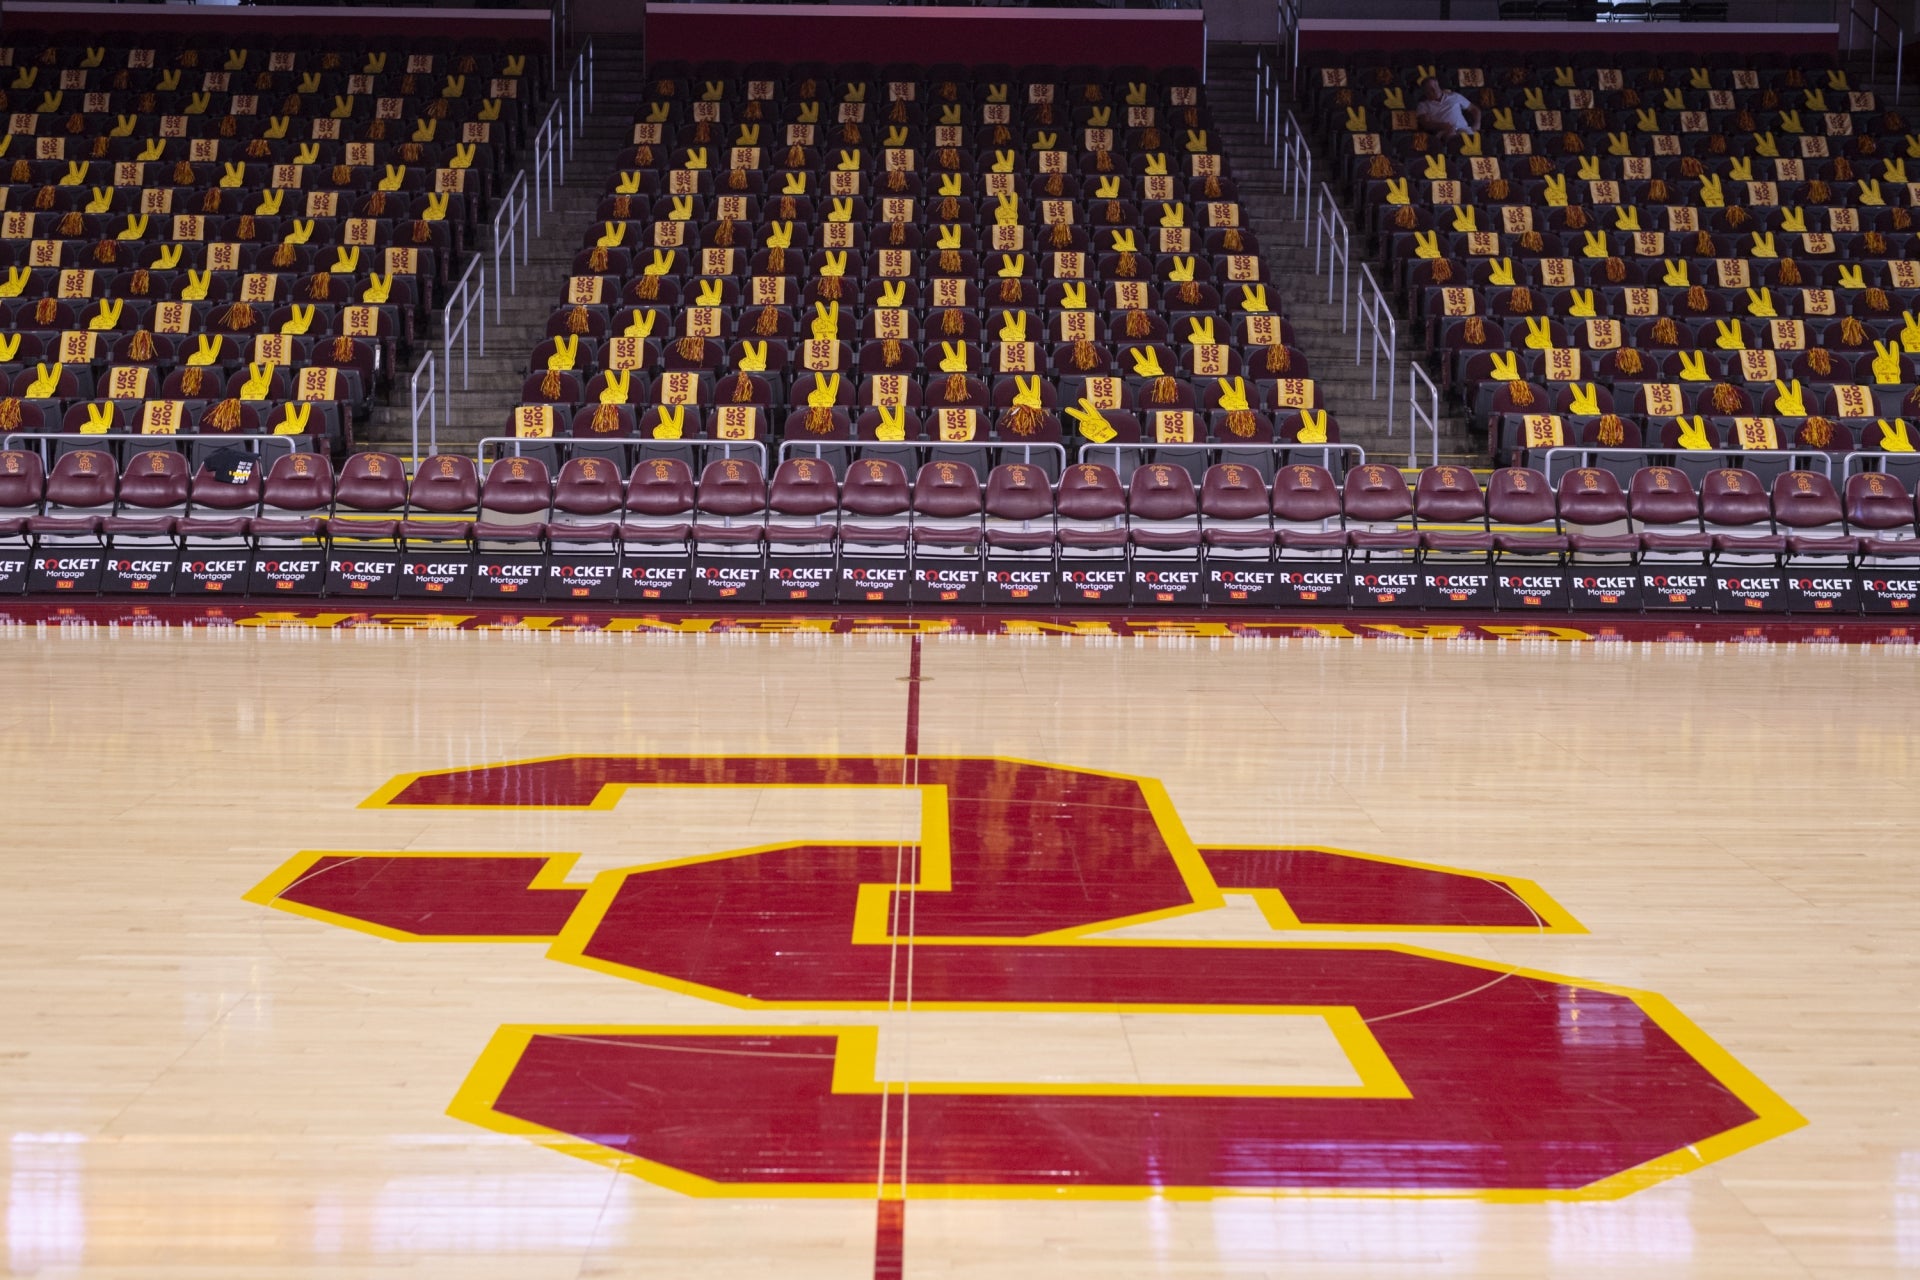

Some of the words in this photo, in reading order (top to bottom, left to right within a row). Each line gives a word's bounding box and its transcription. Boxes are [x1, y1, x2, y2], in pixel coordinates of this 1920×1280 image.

[163, 306, 173, 324] USC
[173, 303, 182, 324] HOO
[694, 309, 702, 325] USC
[1777, 322, 1786, 338] USC
[68, 336, 78, 355] USC
[263, 340, 272, 358] USC
[812, 341, 821, 358] USC
[1007, 345, 1015, 363] USC
[1202, 345, 1210, 362] USC
[1553, 350, 1561, 368] USC
[1748, 351, 1756, 369] USC
[117, 370, 127, 389] USC
[126, 368, 138, 388] HOO
[307, 371, 316, 390] USC
[317, 368, 327, 391] HOO
[670, 374, 679, 392] USC
[880, 376, 889, 394] USC
[1094, 379, 1102, 397] USC
[1652, 385, 1662, 402] USC
[1844, 388, 1853, 406] USC
[151, 406, 162, 425] USC
[524, 408, 533, 427] USC
[726, 408, 735, 426] USC
[948, 410, 956, 429] USC
[1165, 414, 1173, 433] USC
[1542, 415, 1553, 438] HOO
[1533, 420, 1543, 440] USC
[1745, 424, 1755, 443] USC
[34, 559, 100, 570] ROCKET
[107, 560, 172, 572] ROCKET
[181, 560, 246, 573] ROCKET
[255, 561, 320, 572] ROCKET
[330, 561, 395, 573] ROCKET
[404, 564, 467, 575] ROCKET
[46, 570, 84, 578] Mortgage
[119, 572, 157, 580] Mortgage
[194, 572, 231, 580] Mortgage
[267, 572, 305, 580] Mortgage
[343, 573, 380, 581] Mortgage
[478, 565, 542, 577] ROCKET
[550, 566, 614, 577] ROCKET
[622, 568, 686, 579] ROCKET
[696, 567, 759, 580] ROCKET
[769, 568, 833, 579] ROCKET
[843, 568, 906, 580] ROCKET
[916, 569, 978, 581] ROCKET
[1063, 571, 1125, 582] ROCKET
[416, 575, 454, 583] Mortgage
[490, 577, 528, 585] Mortgage
[563, 577, 601, 585] Mortgage
[988, 572, 1050, 583] ROCKET
[1136, 572, 1198, 583] ROCKET
[1211, 571, 1274, 584] ROCKET
[1280, 573, 1343, 584] ROCKET
[1355, 574, 1417, 586] ROCKET
[1426, 575, 1488, 587] ROCKET
[1500, 576, 1562, 588] ROCKET
[1574, 577, 1635, 588] ROCKET
[1644, 576, 1707, 587] ROCKET
[635, 580, 672, 588] Mortgage
[708, 580, 746, 588] Mortgage
[782, 580, 819, 588] Mortgage
[856, 580, 893, 588] Mortgage
[928, 582, 965, 590] Mortgage
[1000, 583, 1038, 591] Mortgage
[1076, 583, 1113, 591] Mortgage
[1149, 583, 1186, 591] Mortgage
[1225, 583, 1261, 591] Mortgage
[1294, 584, 1331, 592] Mortgage
[1369, 586, 1406, 594] Mortgage
[1717, 578, 1780, 590] ROCKET
[1789, 579, 1852, 590] ROCKET
[1514, 588, 1551, 596] Mortgage
[1588, 588, 1625, 596] Mortgage
[1658, 587, 1696, 595] Mortgage
[1732, 590, 1769, 598] Mortgage
[1804, 590, 1841, 598] Mortgage
[1878, 591, 1916, 599] Mortgage
[235, 612, 952, 633] CENTER
[1001, 620, 1594, 640] GALEN
